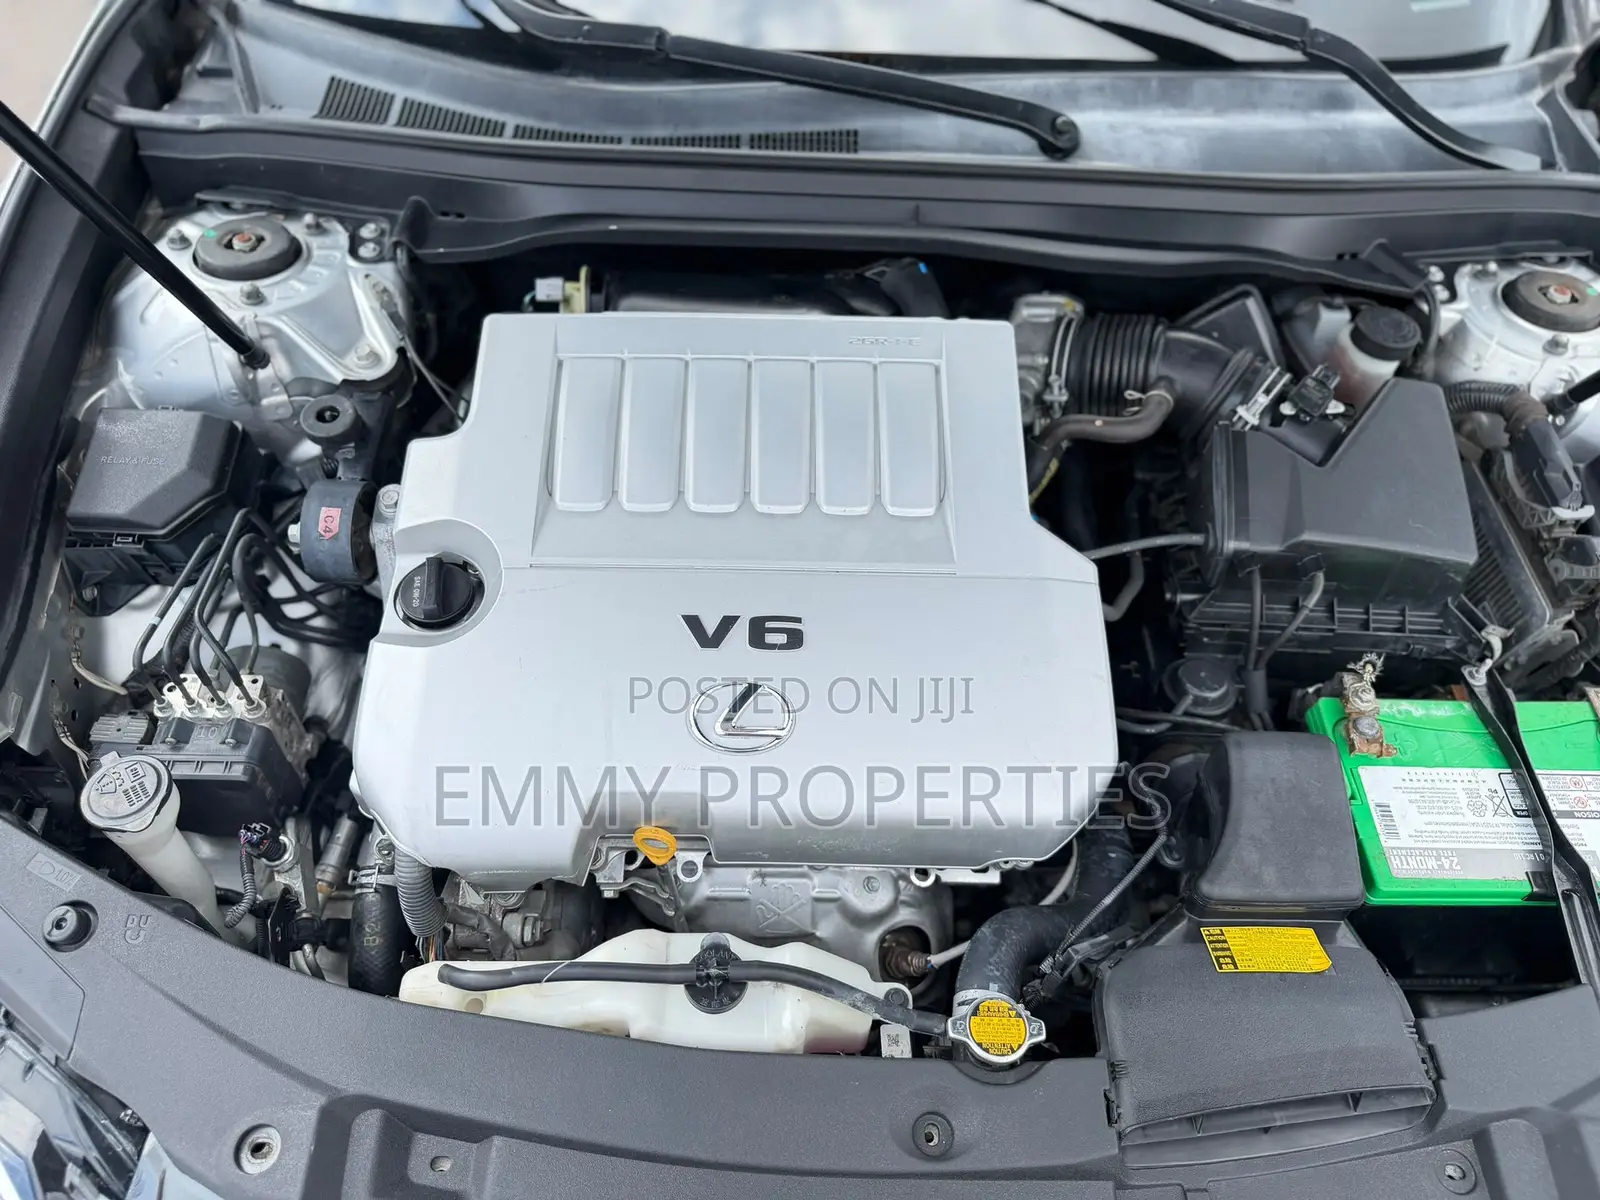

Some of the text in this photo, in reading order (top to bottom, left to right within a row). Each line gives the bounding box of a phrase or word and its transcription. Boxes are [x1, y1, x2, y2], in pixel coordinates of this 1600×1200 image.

[322, 515, 335, 534] C4
[413, 575, 421, 588] SAE
[679, 614, 804, 651] V6
[1390, 855, 1462, 870] 24-MONTH
